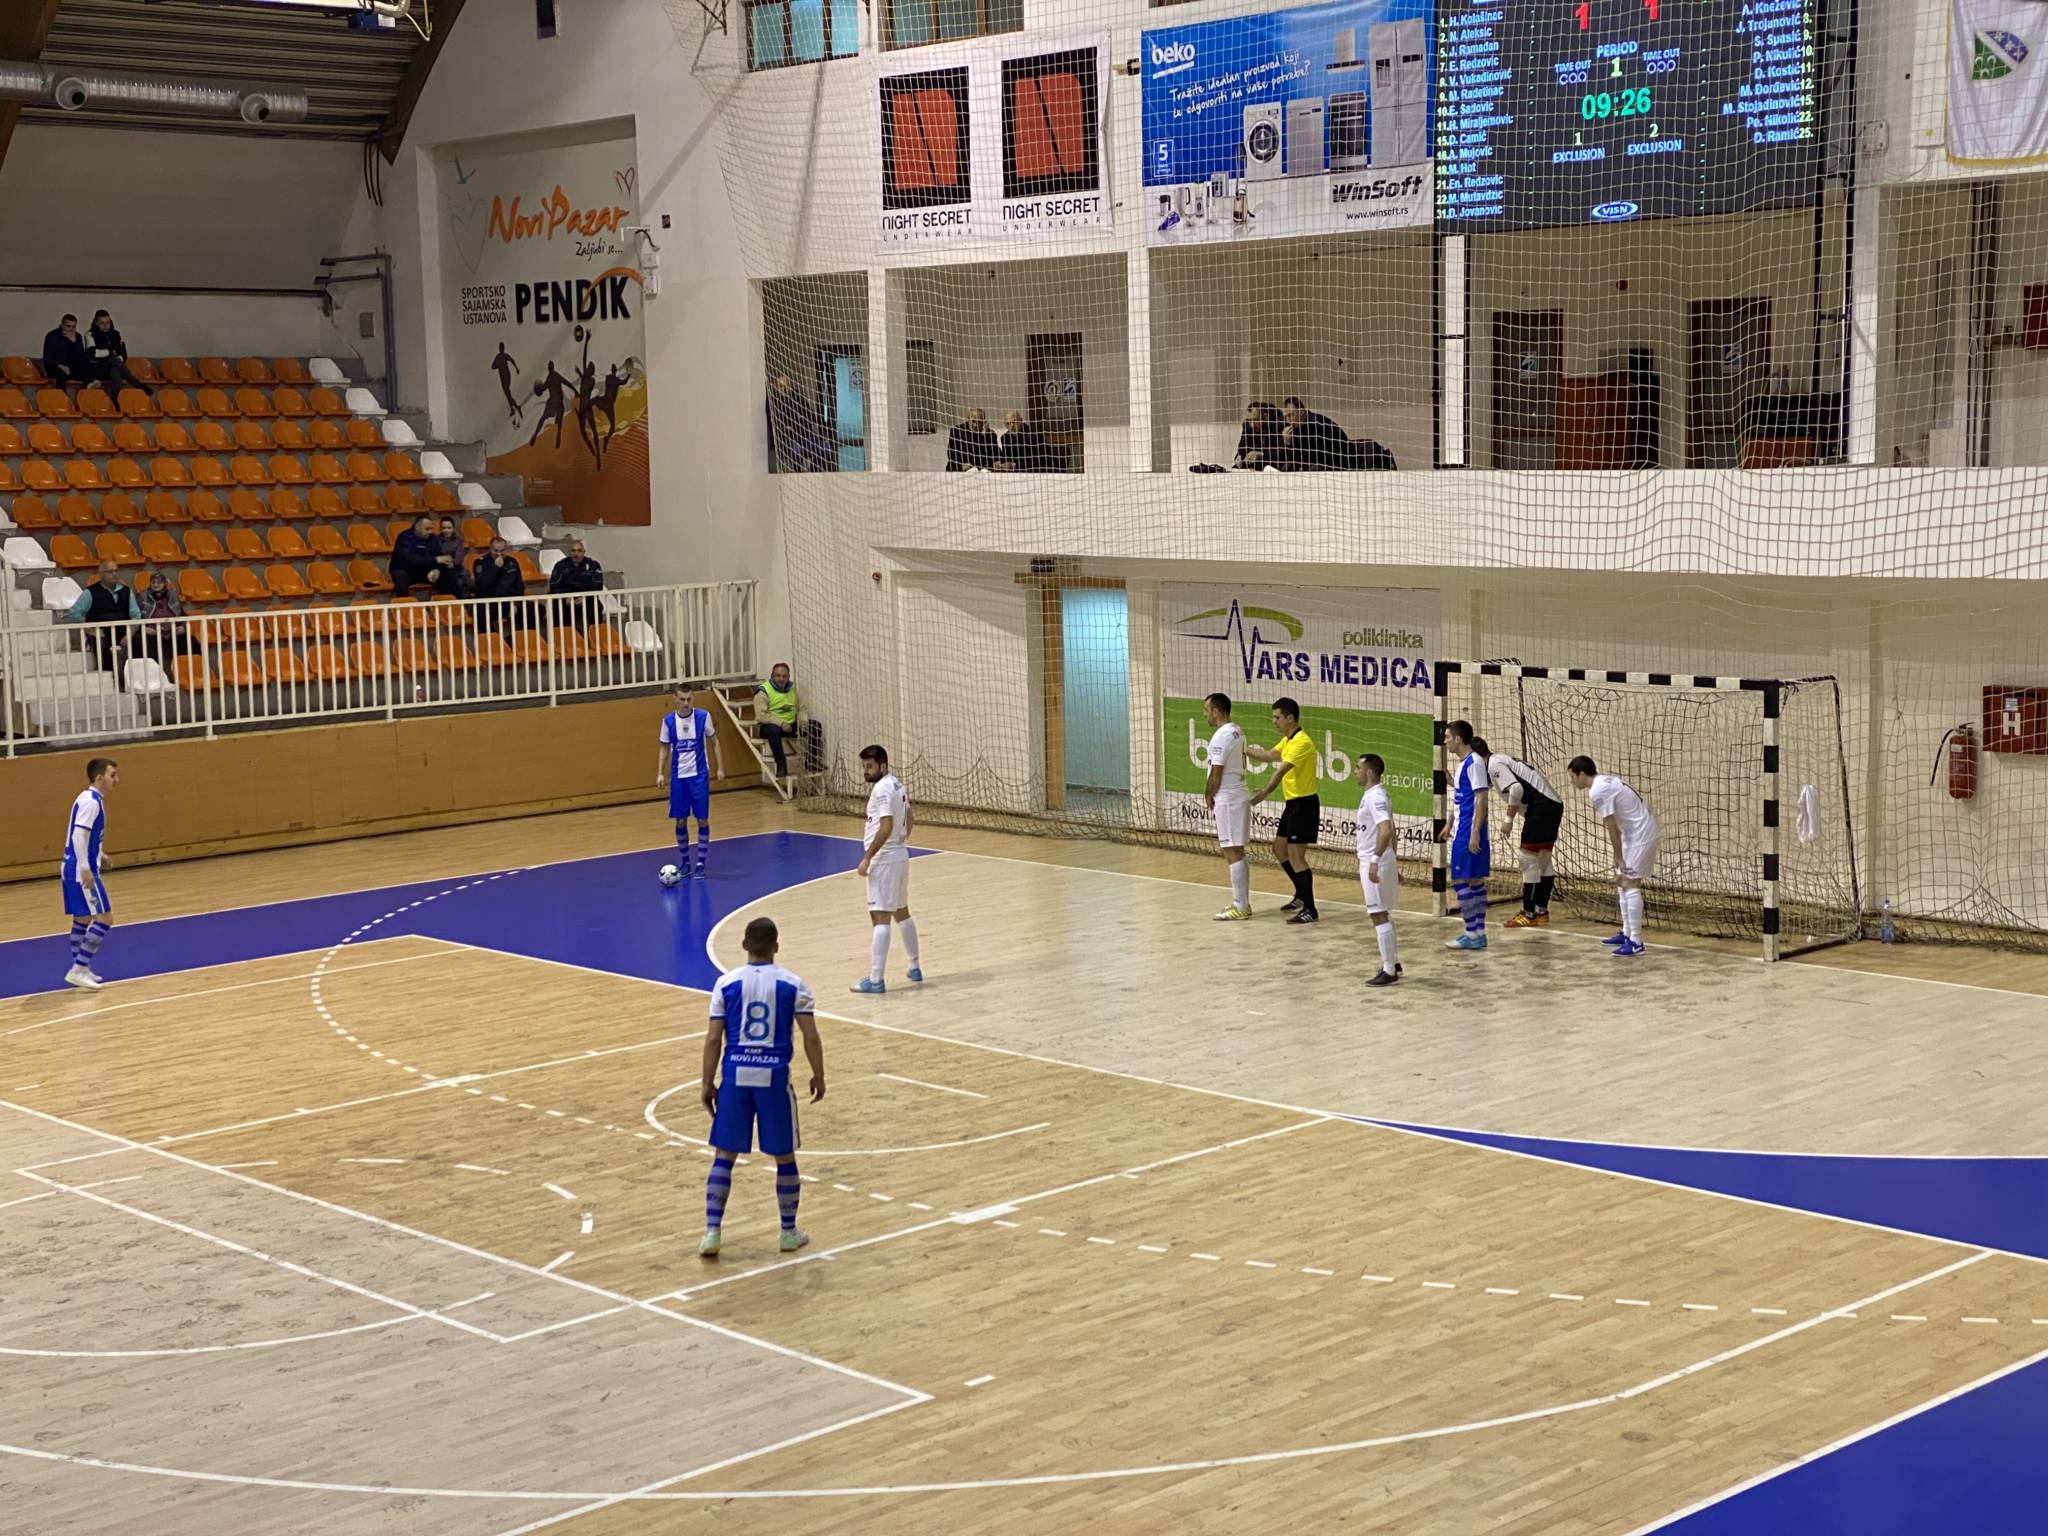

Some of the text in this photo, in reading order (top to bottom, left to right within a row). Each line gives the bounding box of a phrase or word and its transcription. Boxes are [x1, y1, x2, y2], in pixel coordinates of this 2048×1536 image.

[1575, 2, 1589, 30] 1
[1742, 4, 1753, 15] A.
[1449, 16, 1459, 26] H.
[1440, 33, 1448, 43] 2.
[1449, 31, 1458, 41] N.
[1152, 42, 1196, 65] beko
[1597, 41, 1638, 58] PERIOD
[1643, 48, 1680, 61] TIME OUT
[1440, 62, 1448, 72] 7.
[1449, 61, 1459, 71] E.
[1555, 60, 1592, 73] TIME OUT
[1611, 57, 1622, 77] 1
[1169, 49, 1300, 102] Tražite idealan proizvod koji
[1449, 76, 1458, 86] V.
[1231, 88, 1243, 98] na
[1449, 105, 1458, 115] E.
[1582, 87, 1652, 120] 09:26
[1738, 94, 1800, 113] Stojadinović
[1449, 120, 1458, 130] H.
[1649, 123, 1659, 138] 2
[1449, 134, 1458, 144] D.
[1575, 132, 1583, 146] 1
[1627, 138, 1682, 155] EXCLUSION
[1159, 143, 1169, 162] 5
[1449, 149, 1458, 159] A.
[1553, 147, 1605, 163] EXCLUSION
[1448, 164, 1459, 174] M.
[1460, 162, 1476, 173] Hot
[1332, 175, 1423, 203] WinSoft
[488, 184, 630, 243] Novi Pazar
[1046, 196, 1101, 217] SECRET
[1346, 206, 1409, 220] www.winsoft.rs
[922, 208, 972, 227] SECRET
[461, 285, 506, 299] SPORTSKO
[515, 274, 631, 325] PENDIK
[462, 299, 507, 312] SAJAMSKA
[463, 312, 507, 325] USTANOVA
[1342, 627, 1425, 651] poliklinika
[1240, 640, 1432, 689] VARS MEDICA
[2002, 711, 2021, 736] H
[1182, 804, 1210, 821] Novi
[1404, 828, 1433, 843] 444
[744, 1001, 770, 1041] 8
[752, 1055, 780, 1064] PAZAR
